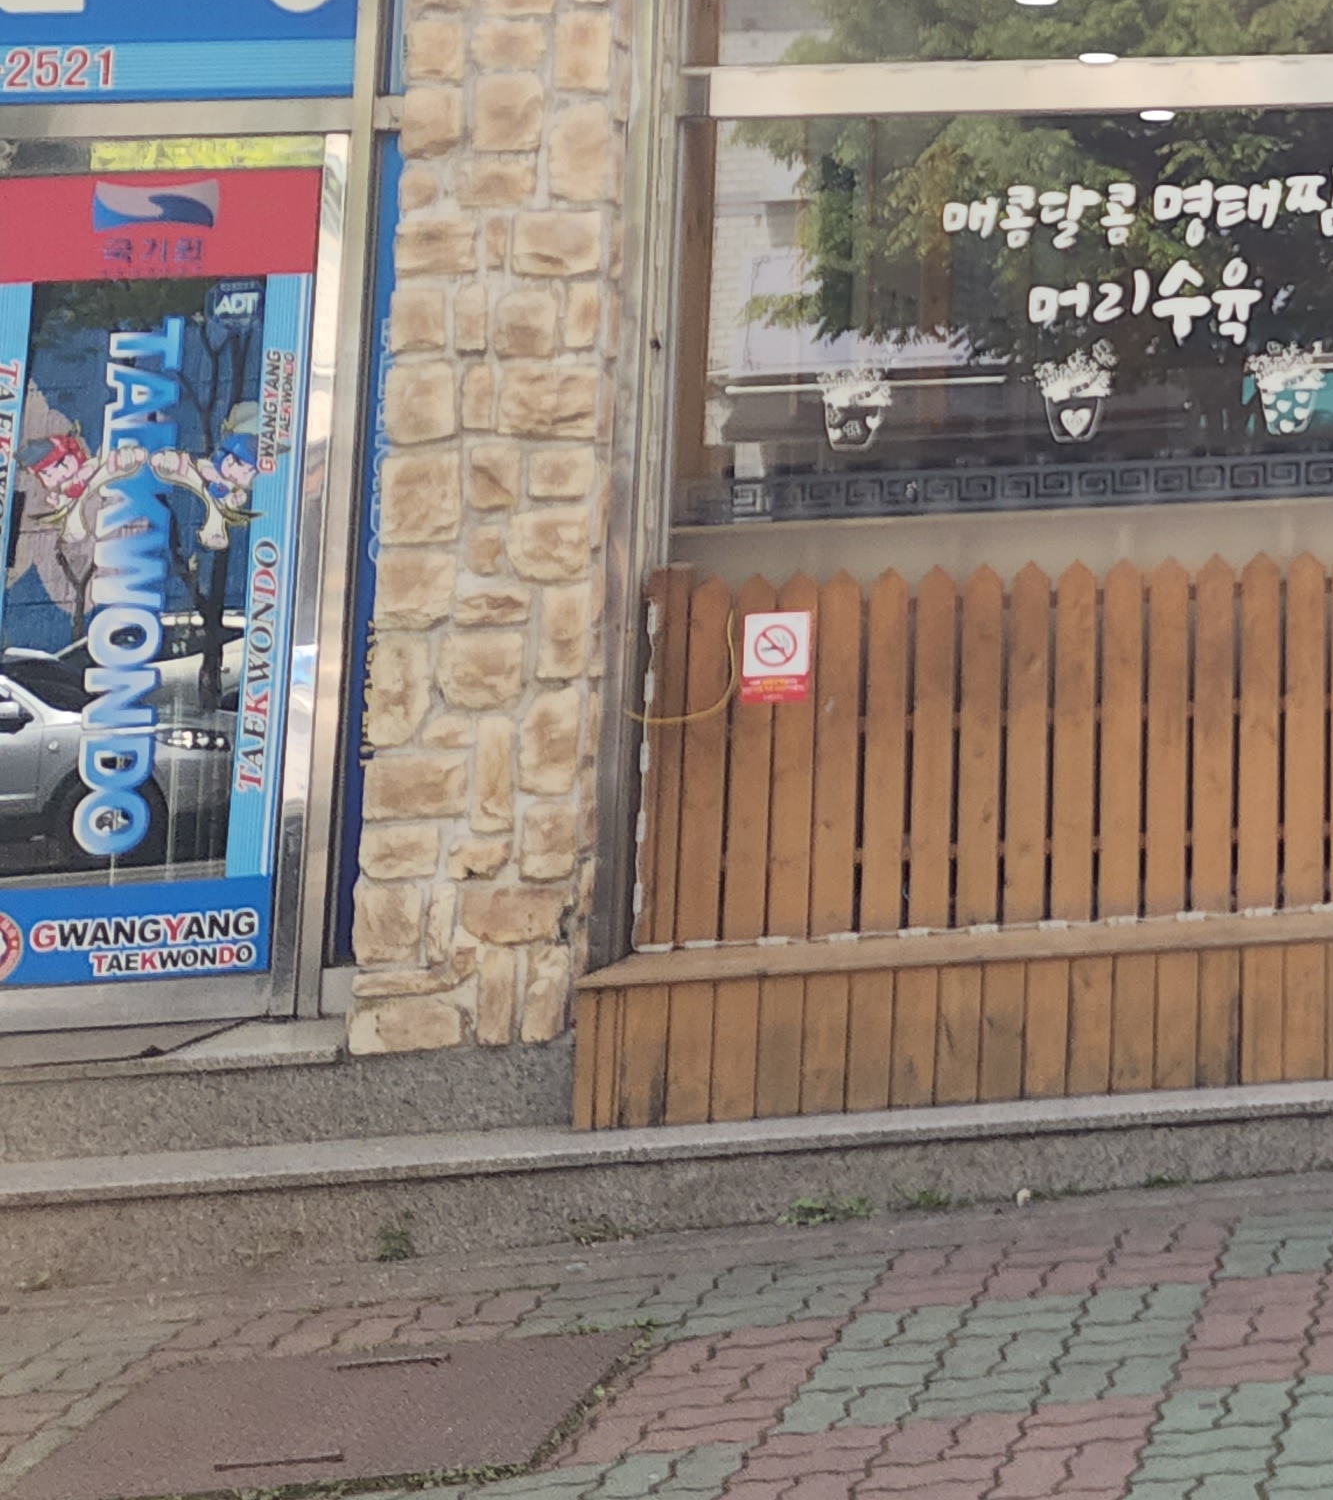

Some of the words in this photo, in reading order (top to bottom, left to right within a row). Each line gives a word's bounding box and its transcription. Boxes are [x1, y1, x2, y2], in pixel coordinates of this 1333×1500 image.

[944, 180, 1137, 250] 매콤달콤
[103, 238, 204, 263] 국기원
[214, 292, 260, 316] ADT
[1028, 258, 1264, 345] 머리수육
[258, 348, 282, 474] GWANGYANG
[279, 352, 297, 441] TAEKWONDO
[237, 537, 280, 792] TAEKWONDO
[32, 910, 257, 950] GWANGYANG
[91, 944, 254, 974] TAEKWONDO
